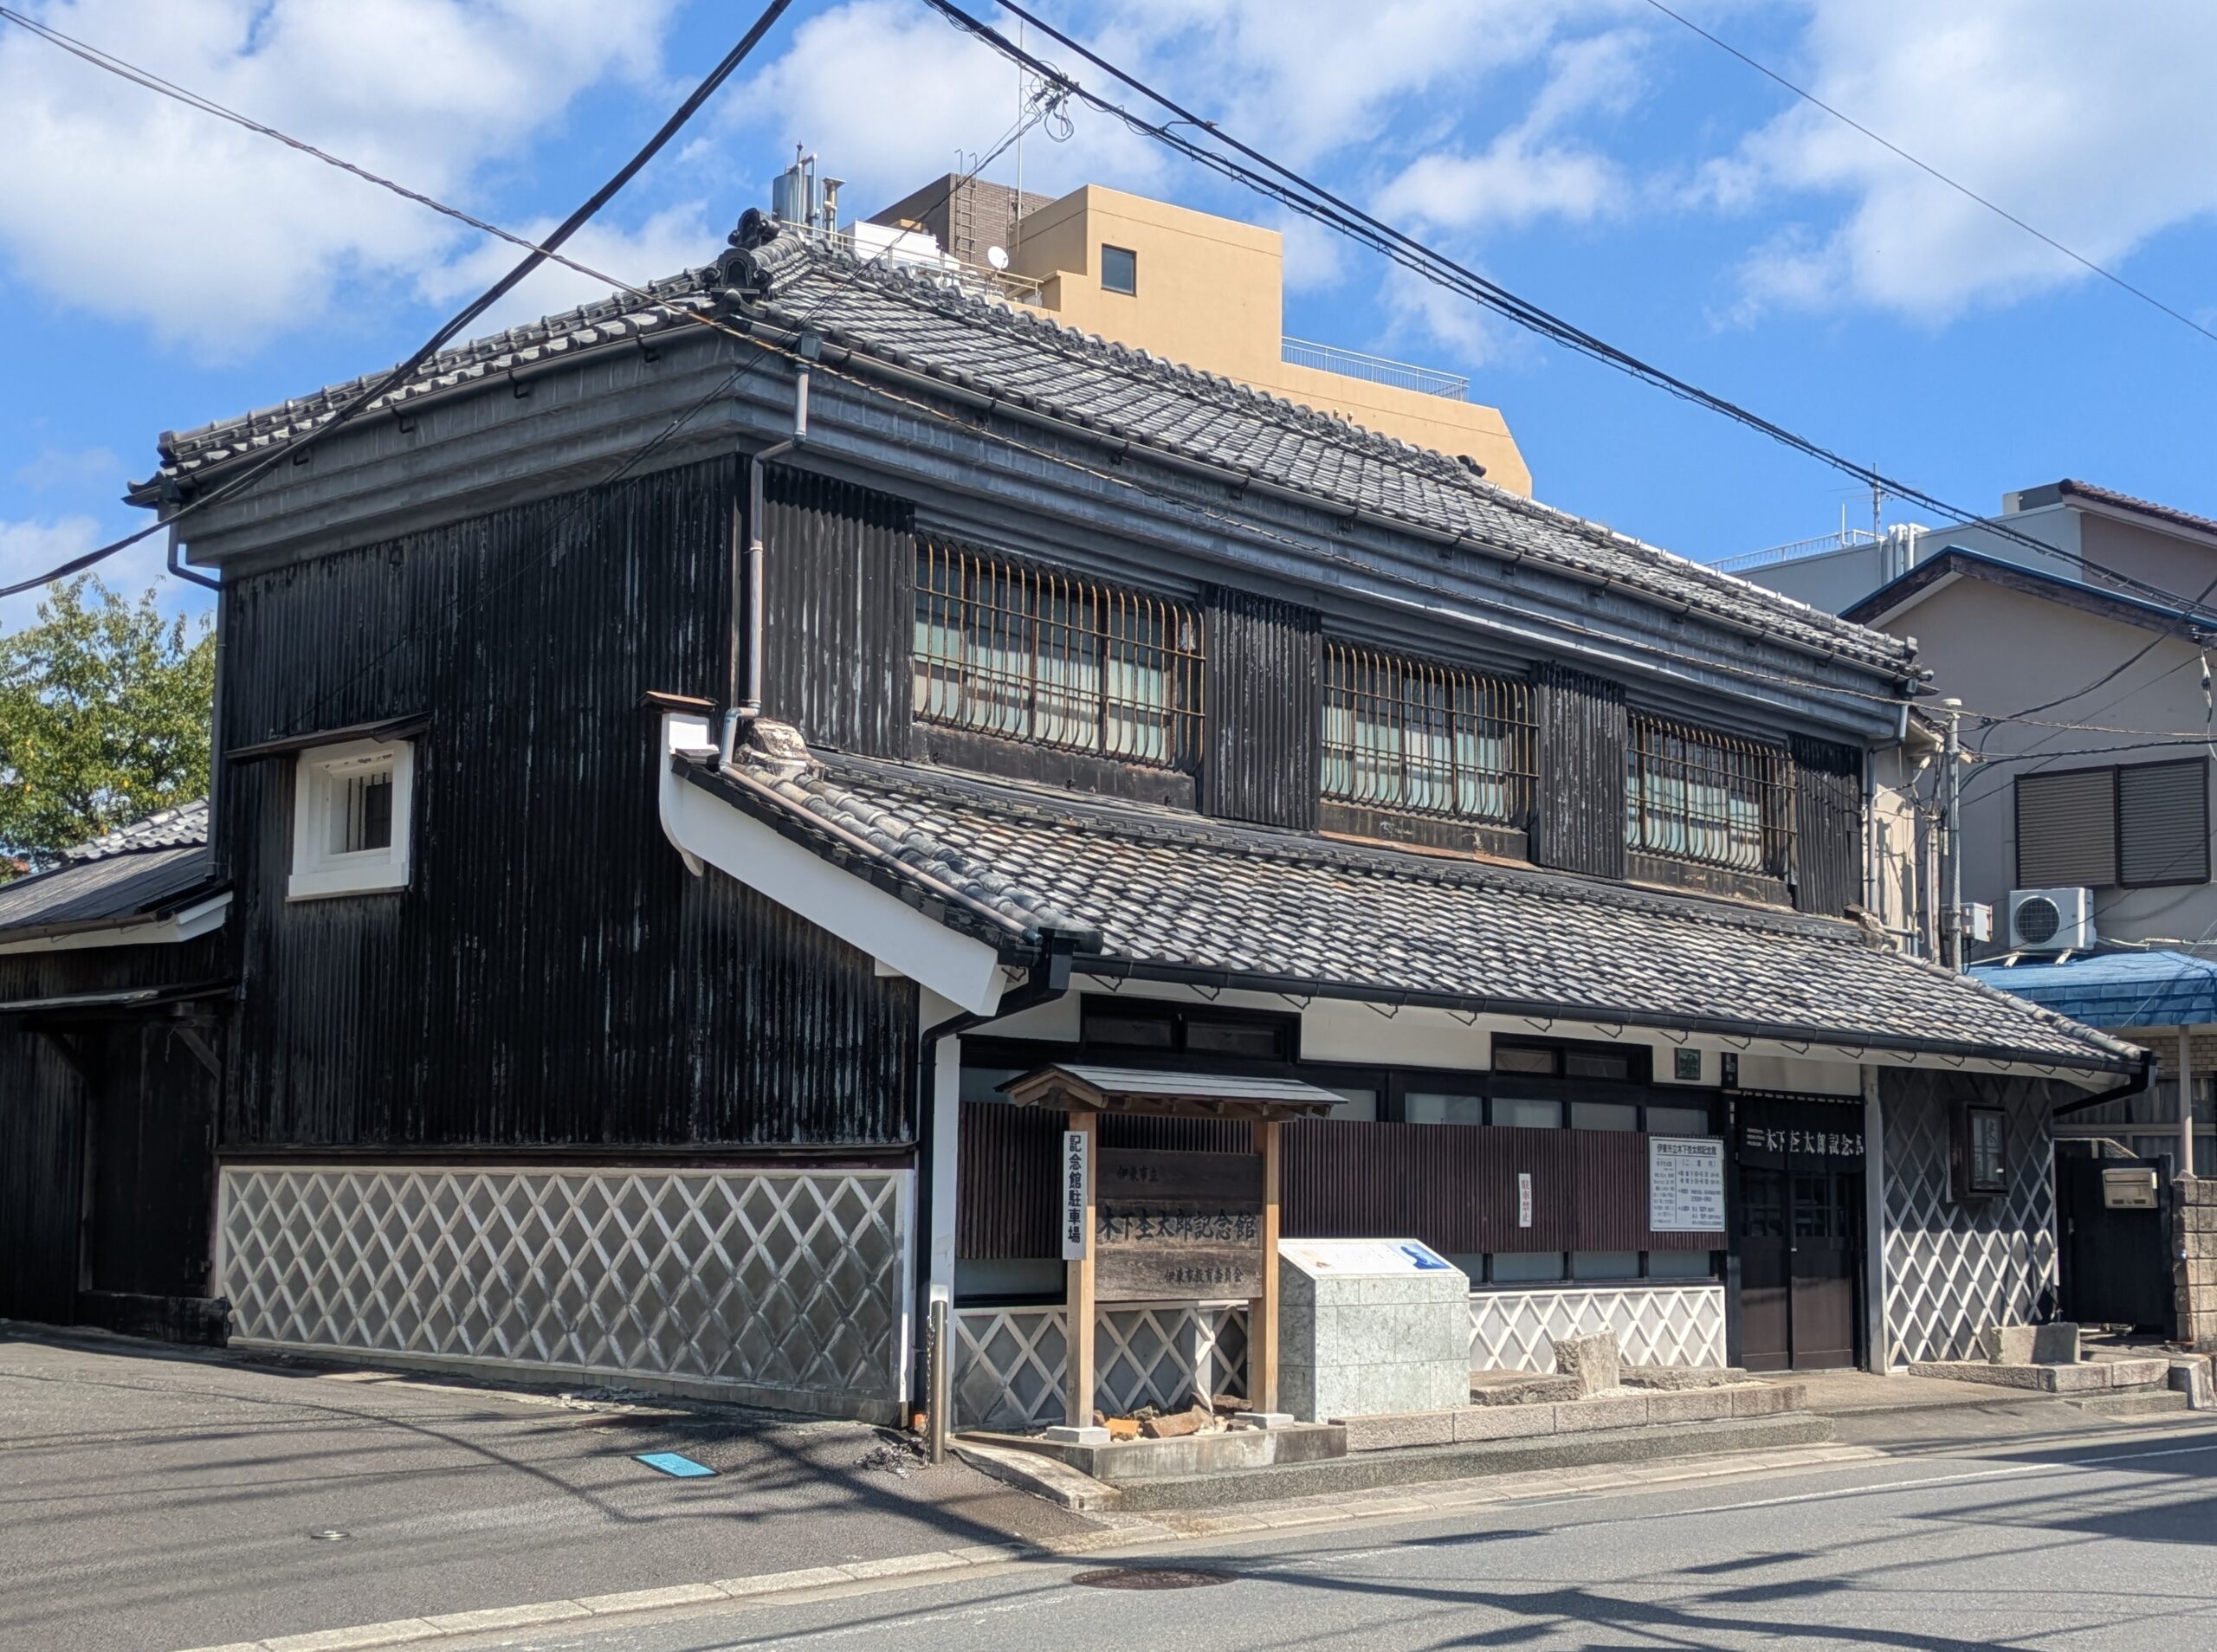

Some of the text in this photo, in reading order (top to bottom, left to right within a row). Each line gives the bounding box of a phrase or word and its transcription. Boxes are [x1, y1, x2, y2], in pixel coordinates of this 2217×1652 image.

[1067, 1134, 1082, 1243] 記念館駐車場
[1521, 1179, 1531, 1223] 駐車禁止
[1098, 1205, 1256, 1242] 木下杢太郎記念館
[1164, 1266, 1244, 1286] 伊東市教育委員会
